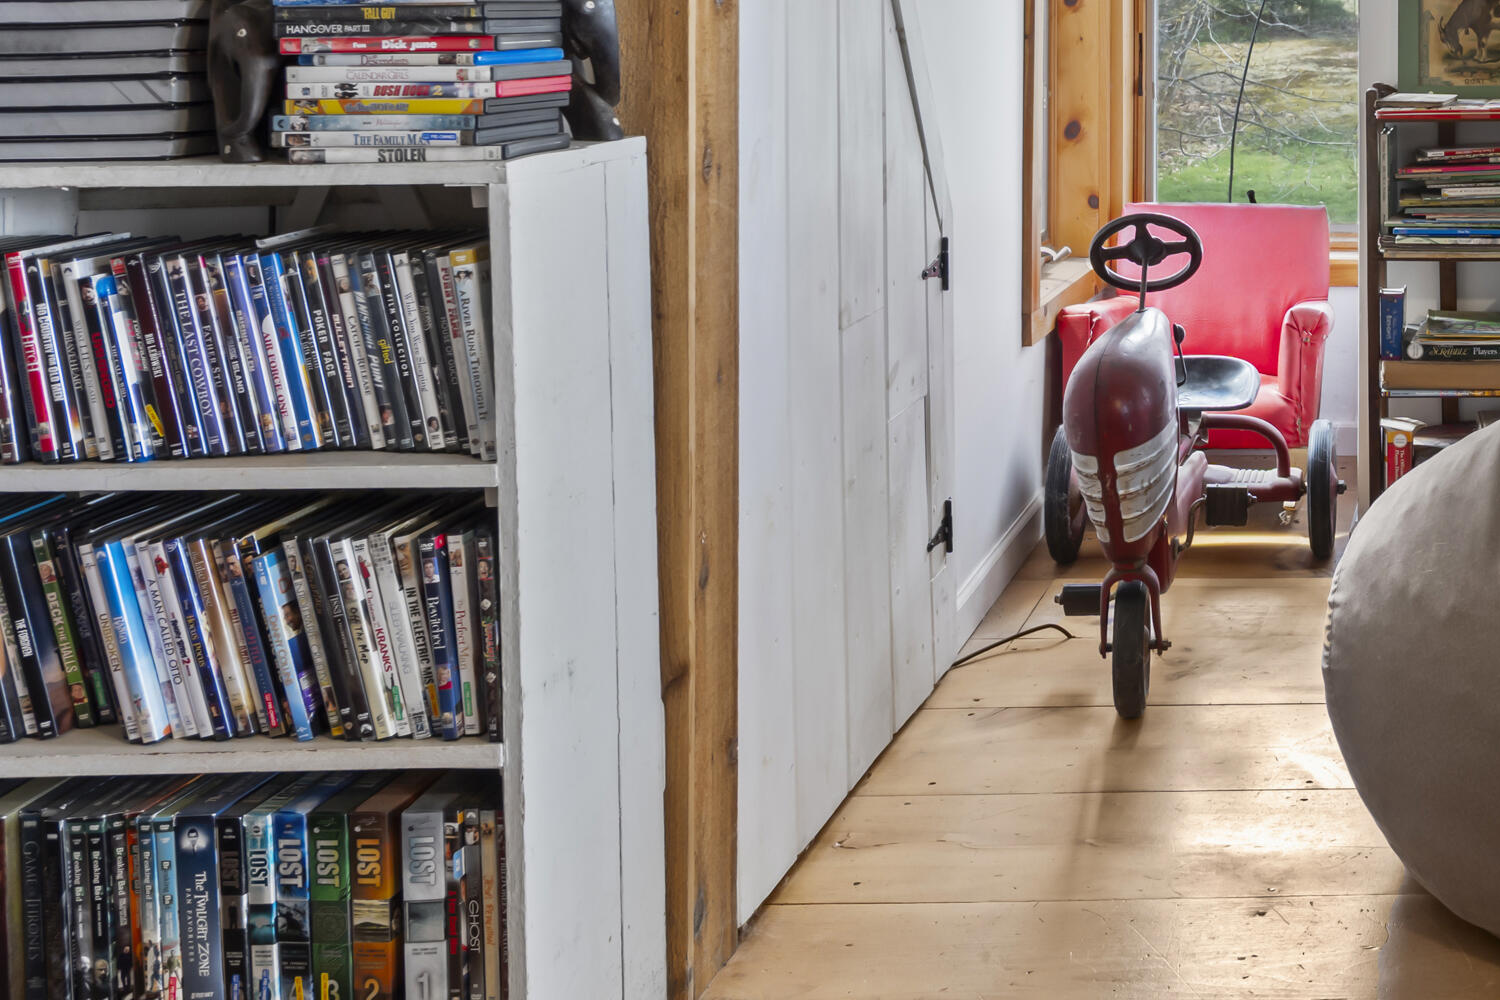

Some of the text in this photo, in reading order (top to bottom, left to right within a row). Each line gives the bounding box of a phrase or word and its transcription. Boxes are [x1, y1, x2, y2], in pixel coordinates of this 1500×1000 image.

[286, 25, 343, 34] HANGOVER
[362, 24, 371, 32] III
[381, 7, 396, 19] GUY
[381, 40, 407, 49] Dick
[373, 85, 402, 97] RUSH
[432, 85, 444, 96] 2
[353, 134, 372, 146] THE
[373, 134, 410, 146] FAMILY
[378, 148, 426, 163] STOLEN
[236, 310, 250, 345] RAISING
[441, 267, 461, 339] FUNNY FARM
[22, 335, 39, 372] HITCH
[36, 303, 65, 402] NO COUNTRY OLD MEN
[144, 333, 163, 378] BIG LEBOWSKI
[175, 290, 213, 417] THE LAST COWBOY
[202, 325, 217, 365] FATHER
[313, 309, 336, 377] POKER FACE
[333, 314, 355, 389] BULLET TRAIN
[347, 315, 371, 396] CATCH RELEASE
[355, 291, 385, 390] VANISHING POINT
[378, 339, 395, 364] gifted
[386, 293, 396, 314] FILM
[392, 320, 409, 377] COLLECTION
[1472, 346, 1497, 355] Players
[64, 331, 82, 390] BRAVEHEART
[231, 361, 245, 394] ISLAND
[262, 332, 289, 417] AIR FORCE ONE
[15, 618, 34, 657] THE FORGIVEN
[47, 592, 77, 673] DECK THE HALLS
[99, 613, 121, 673] UNBROKEN
[147, 579, 183, 686] A MAN CALLED OTTO
[186, 615, 206, 668] HOCUS POCUS
[389, 602, 410, 675] SLEEPWALKING
[405, 587, 435, 685] IN THE ELECTRIC MIS
[426, 596, 447, 649] Bewitched
[455, 610, 468, 645] Perfect
[181, 657, 191, 665] 2
[375, 627, 393, 673] KRANKS
[72, 851, 85, 902] Breaking Bad
[92, 851, 104, 900] Breaking Bad
[116, 847, 125, 880] Breaking
[143, 851, 151, 884] Breaking
[194, 871, 207, 891] The
[222, 851, 239, 888] LOST
[249, 850, 268, 887] LOST
[278, 839, 302, 888] LOST
[316, 840, 340, 888] LOST
[357, 839, 381, 888] LOST
[409, 837, 436, 886] LOST
[22, 840, 41, 960] GAME THRONES
[118, 880, 127, 896] Bad
[185, 888, 195, 962] FAN FAVORITES
[193, 891, 209, 940] TWILIGHT
[468, 900, 480, 953] GHOST
[197, 942, 210, 977] ZONE
